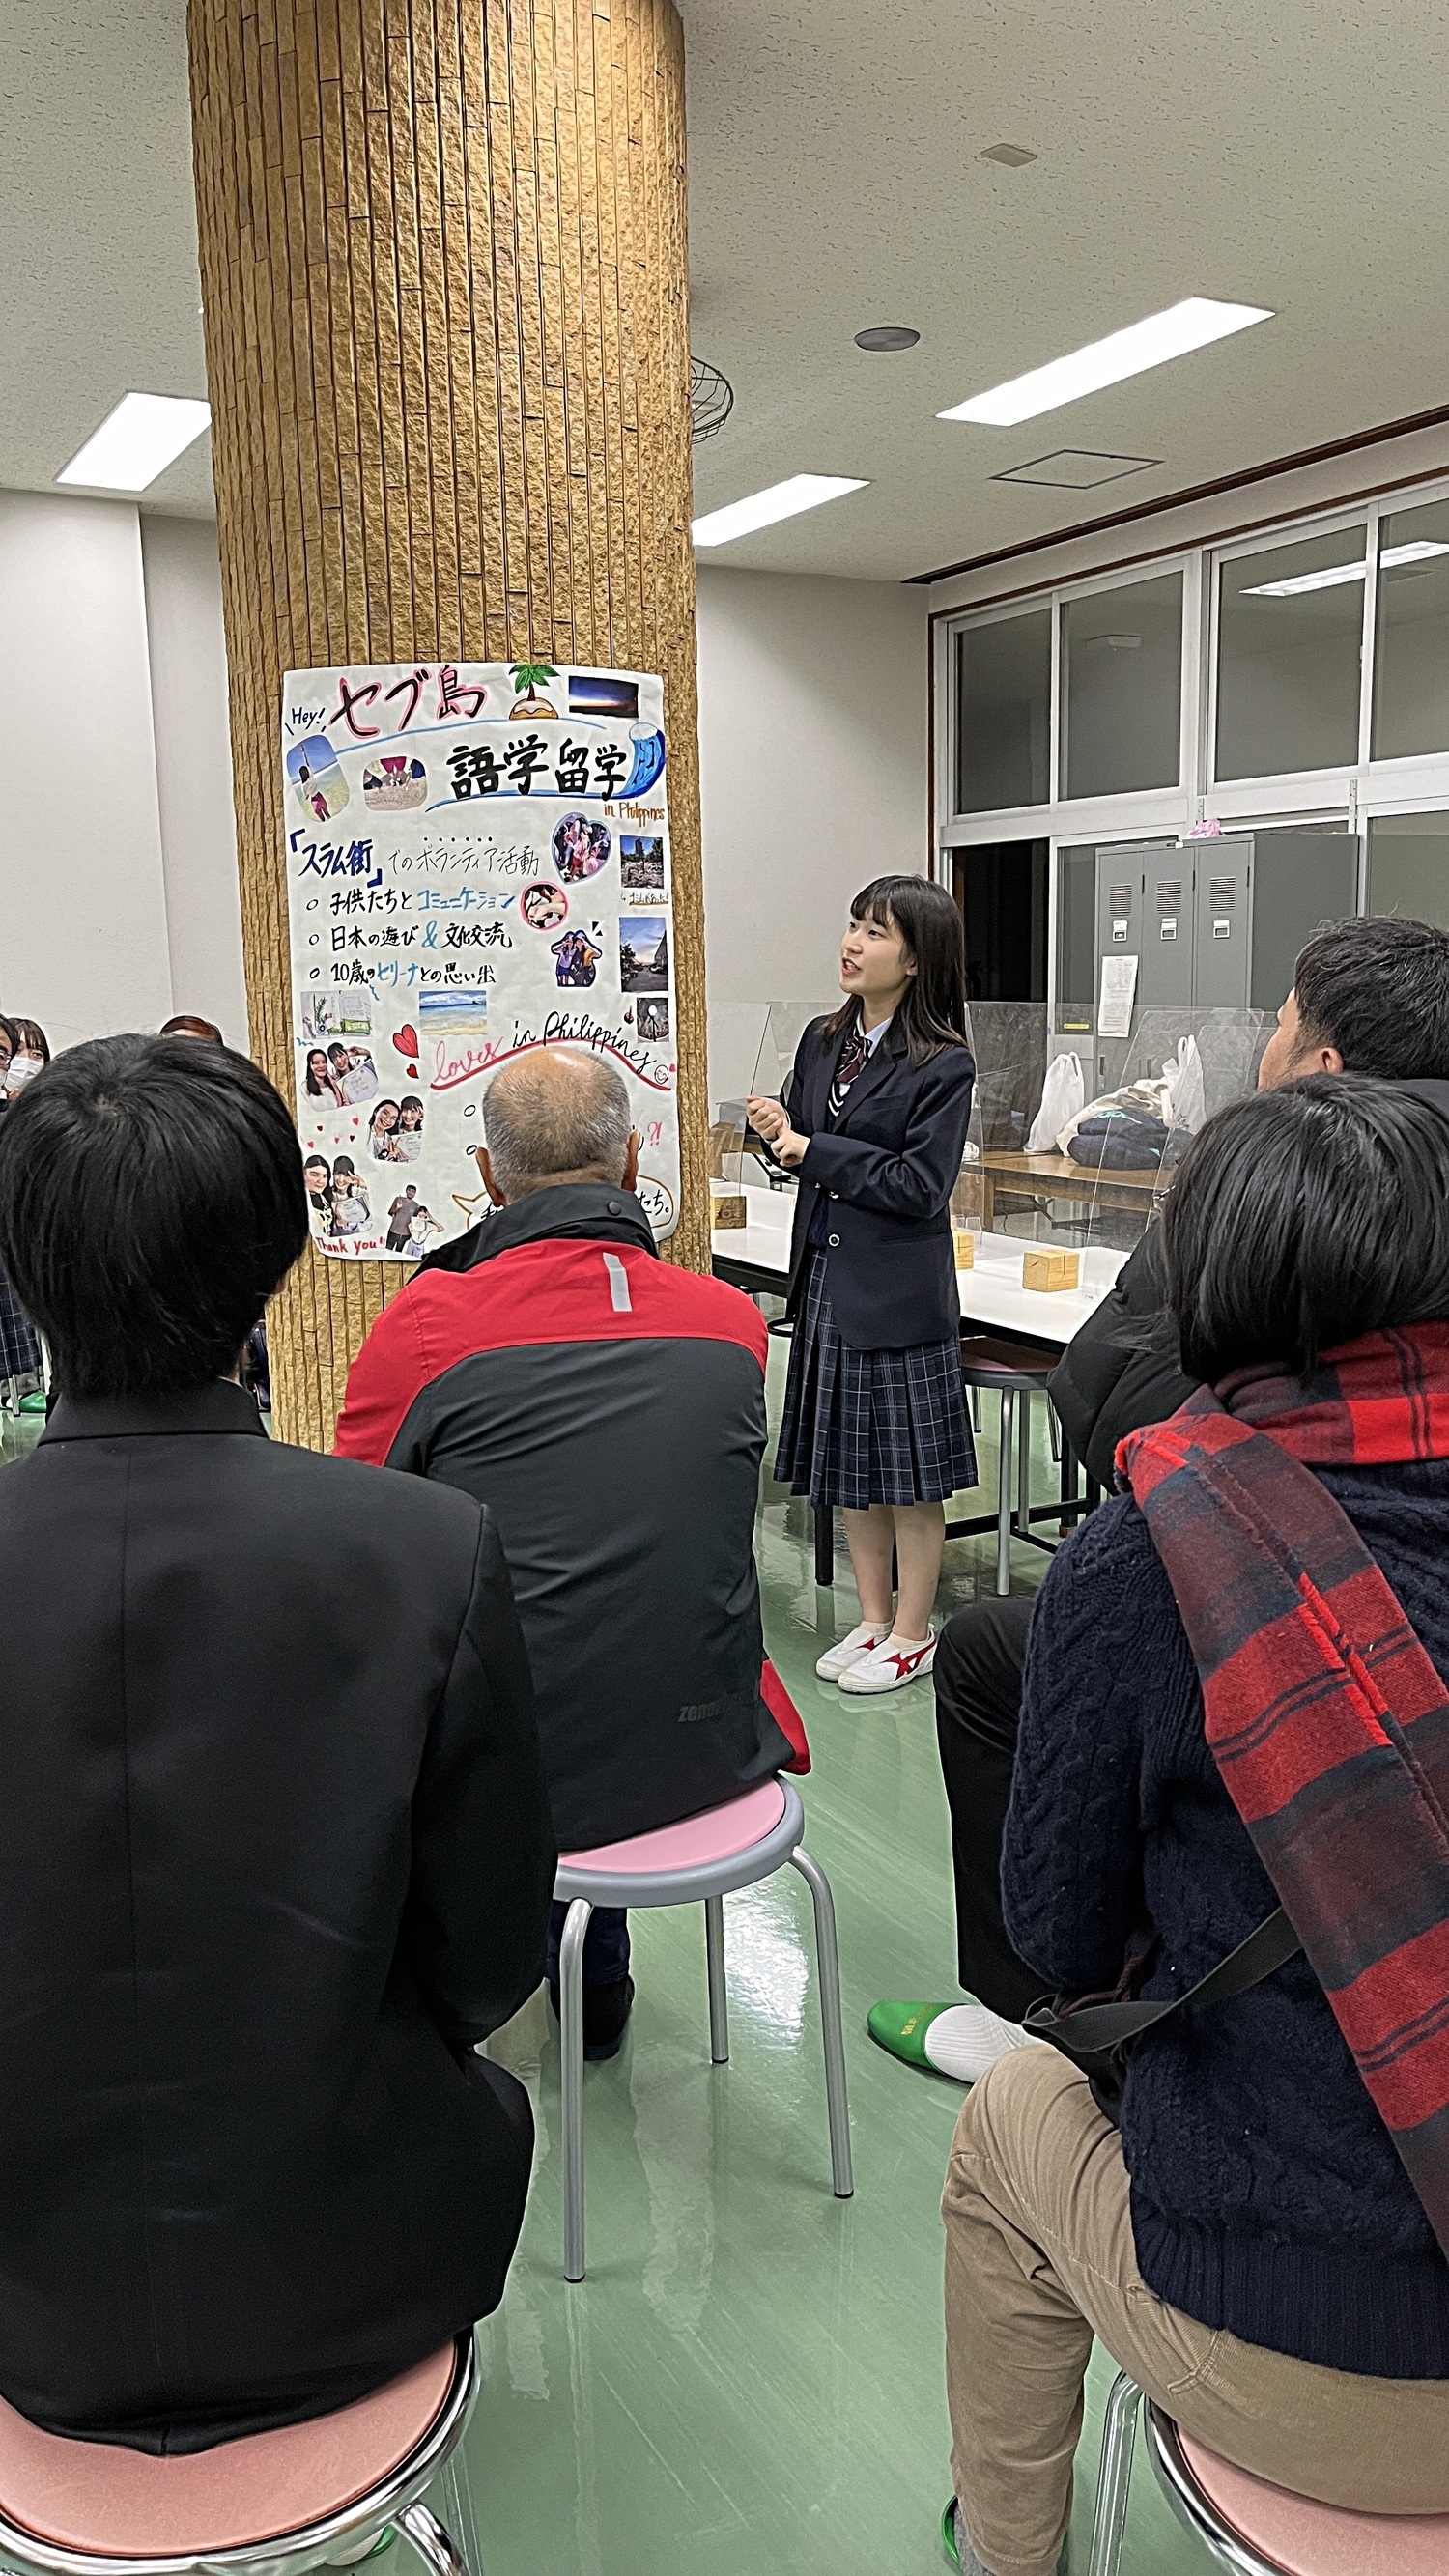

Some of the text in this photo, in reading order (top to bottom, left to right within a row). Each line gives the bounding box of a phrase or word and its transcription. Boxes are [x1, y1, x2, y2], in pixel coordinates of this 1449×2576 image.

[329, 664, 489, 740] セブ島
[292, 708, 325, 730] Hey!
[446, 734, 627, 801] 語学留学
[604, 804, 616, 817] in
[512, 1020, 536, 1049] in
[315, 1236, 348, 1254] Thank
